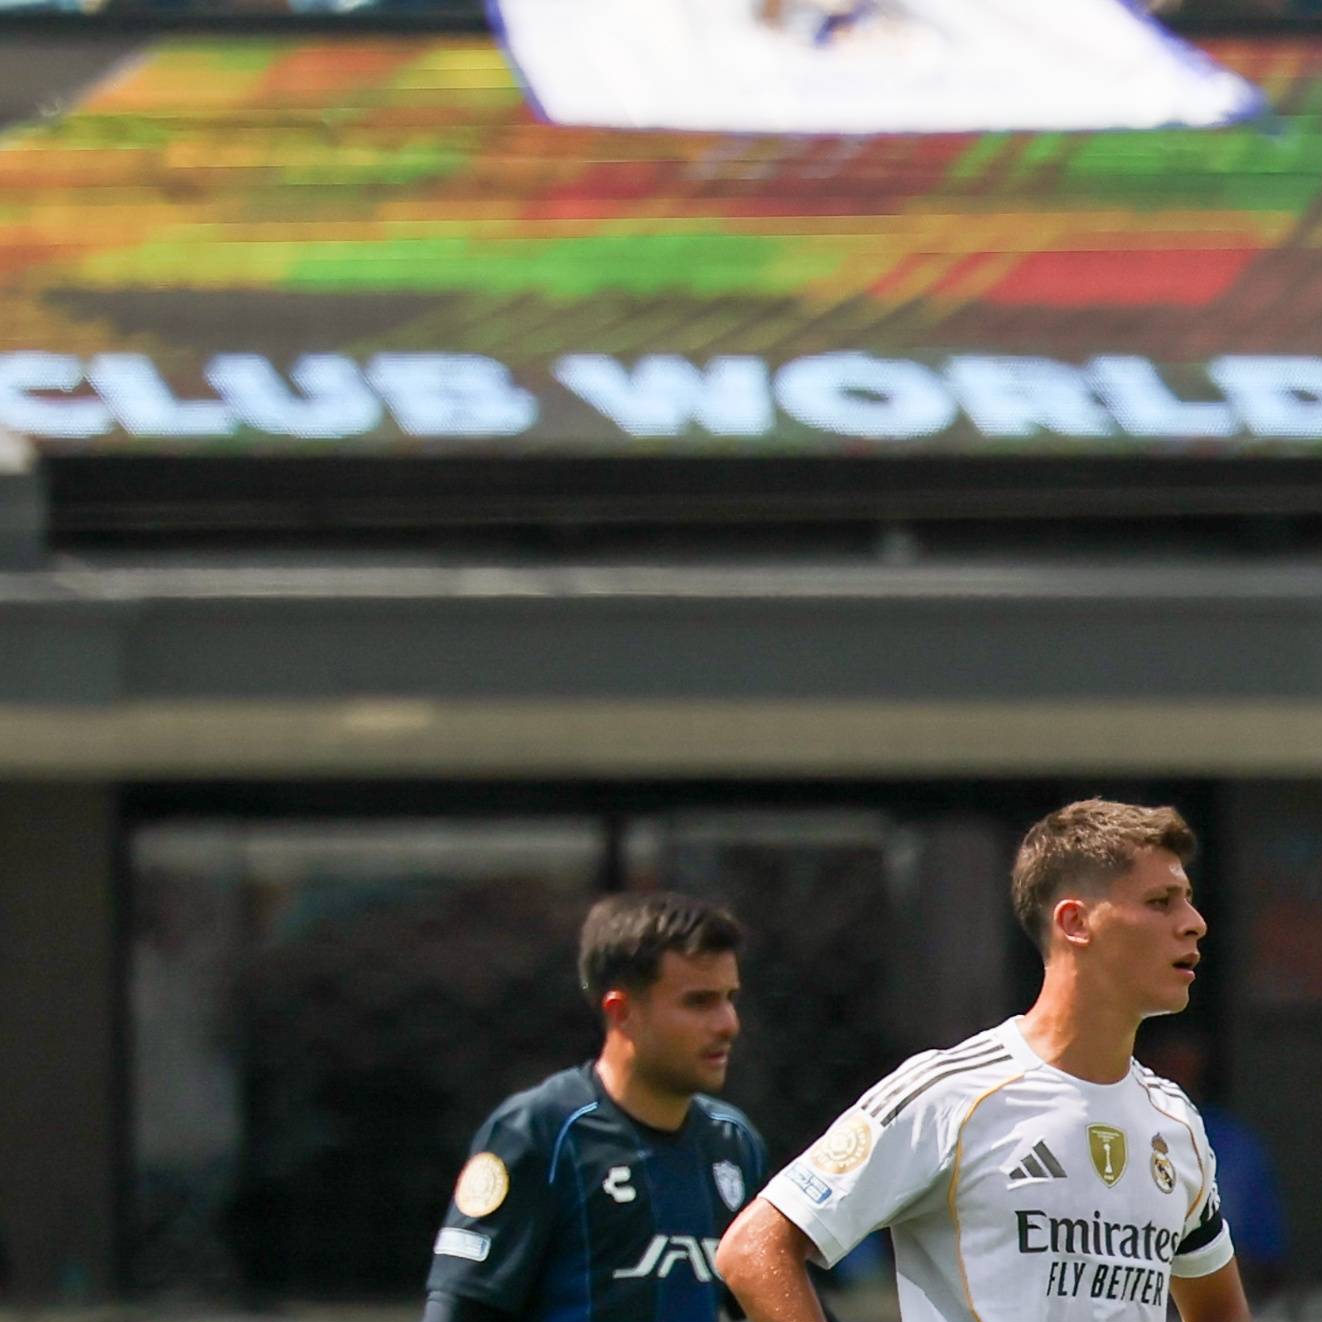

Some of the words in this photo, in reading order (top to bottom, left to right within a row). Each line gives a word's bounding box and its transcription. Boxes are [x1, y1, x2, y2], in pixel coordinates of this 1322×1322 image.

[0, 351, 540, 438] CLUB
[1014, 1209, 1180, 1265] Emirates
[1046, 1260, 1087, 1297] FLY
[1090, 1263, 1164, 1307] BETTER
